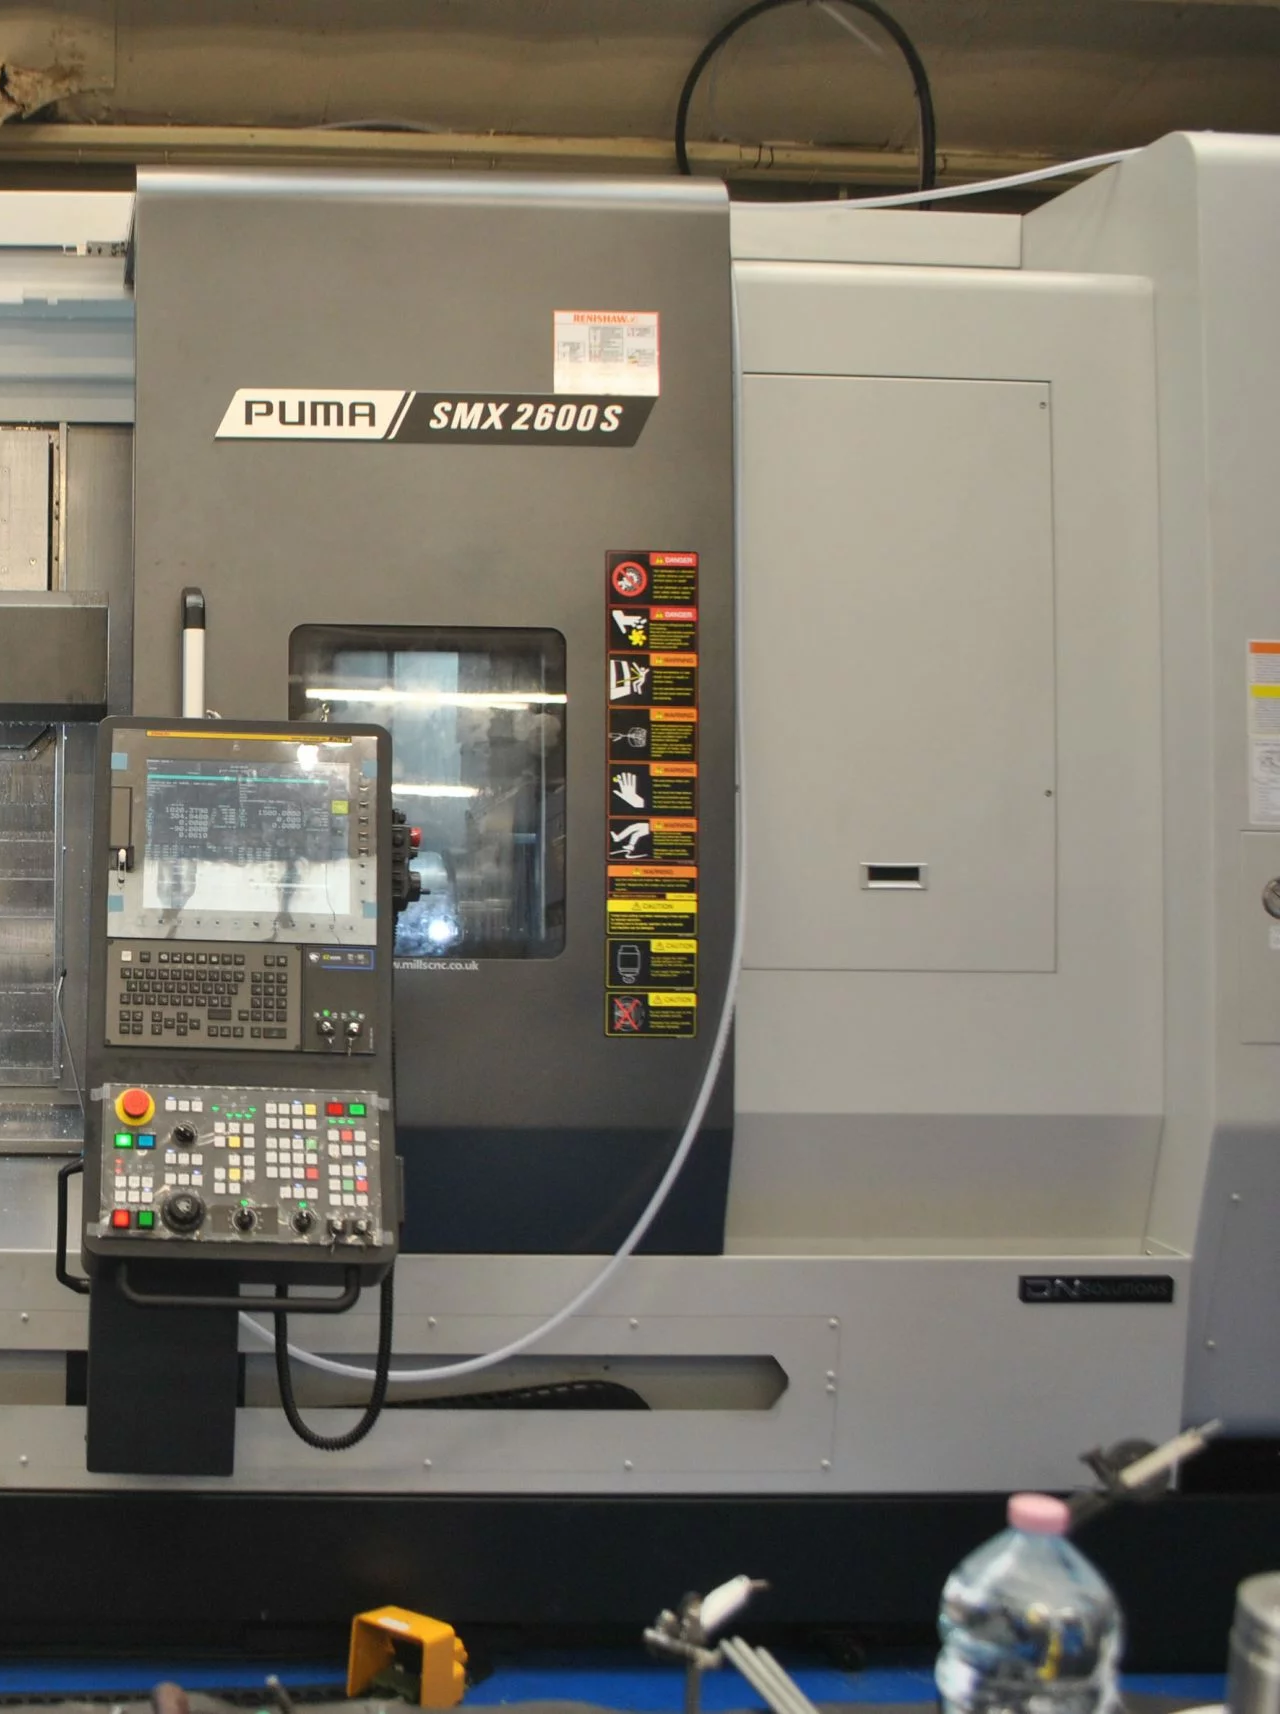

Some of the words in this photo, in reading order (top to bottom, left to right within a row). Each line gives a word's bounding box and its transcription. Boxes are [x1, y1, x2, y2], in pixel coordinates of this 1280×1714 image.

[245, 400, 376, 427] PUMA
[429, 401, 509, 431] SMX
[665, 556, 693, 564] DANGER
[642, 902, 674, 910] CAUTION
[665, 942, 694, 950] CAUTION
[664, 996, 692, 1004] CAUTION
